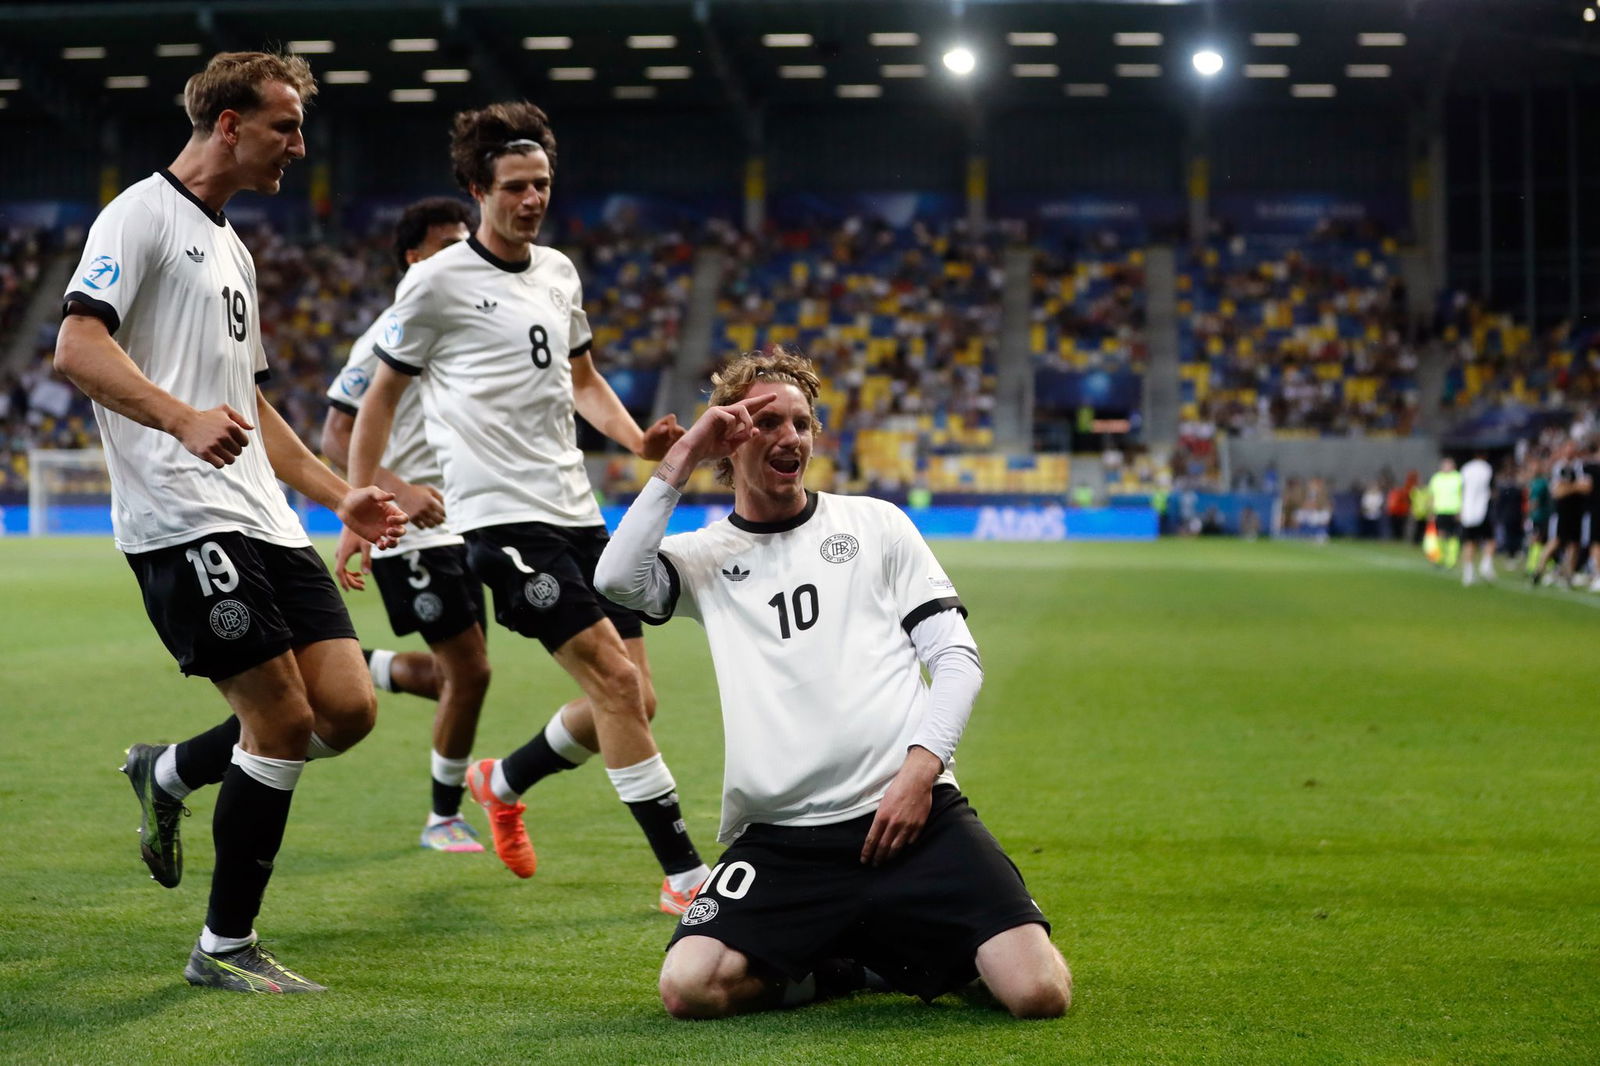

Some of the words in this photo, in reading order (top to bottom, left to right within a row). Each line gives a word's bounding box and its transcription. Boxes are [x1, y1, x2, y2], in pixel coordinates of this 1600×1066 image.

[221, 285, 246, 342] 19
[529, 324, 552, 369] 8
[185, 541, 239, 597] 19
[402, 550, 431, 589] 3
[767, 583, 820, 639] 10
[698, 861, 756, 900] 10
